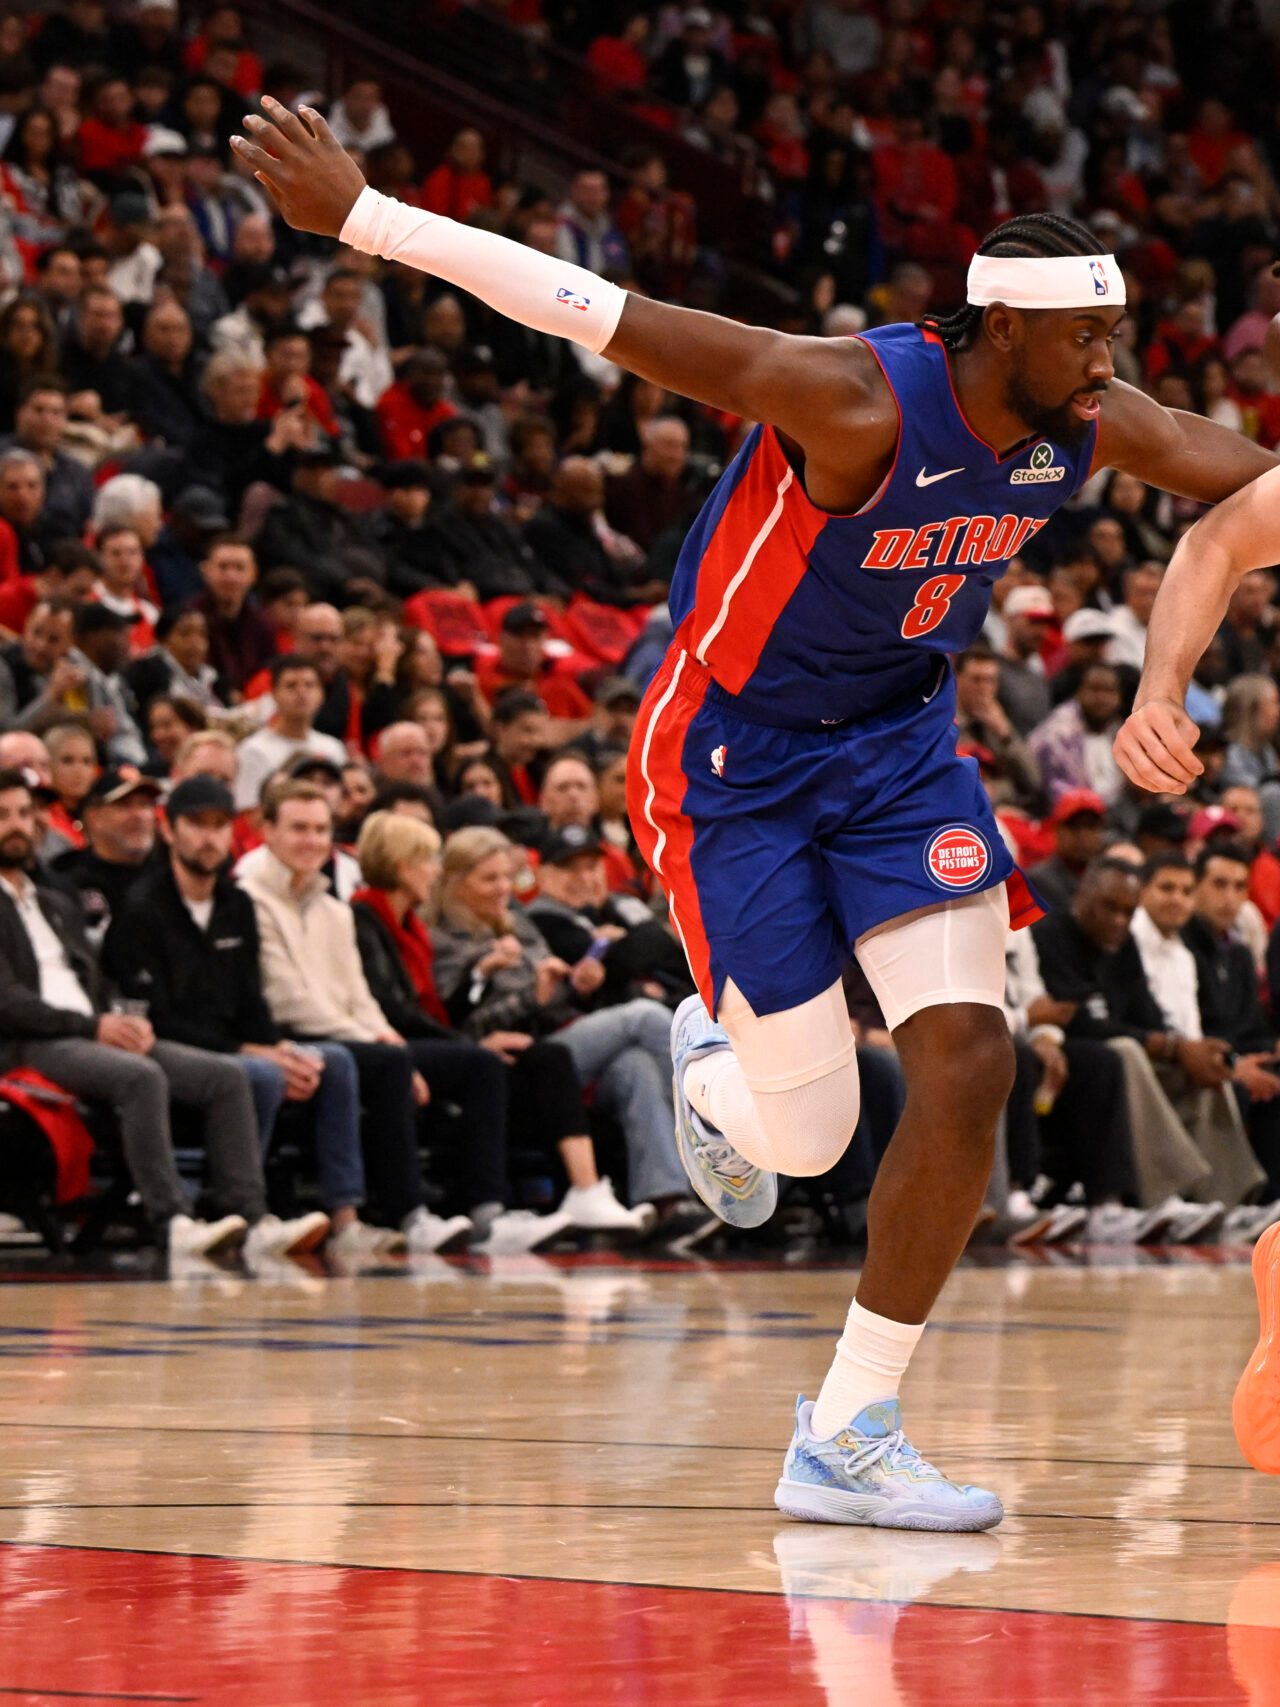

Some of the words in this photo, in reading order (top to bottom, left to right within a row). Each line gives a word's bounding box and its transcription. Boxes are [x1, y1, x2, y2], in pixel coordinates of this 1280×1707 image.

[1012, 469, 1063, 482] StockX
[901, 573, 967, 640] 8
[938, 846, 977, 859] DETROIT
[939, 856, 980, 871] PISTONS
